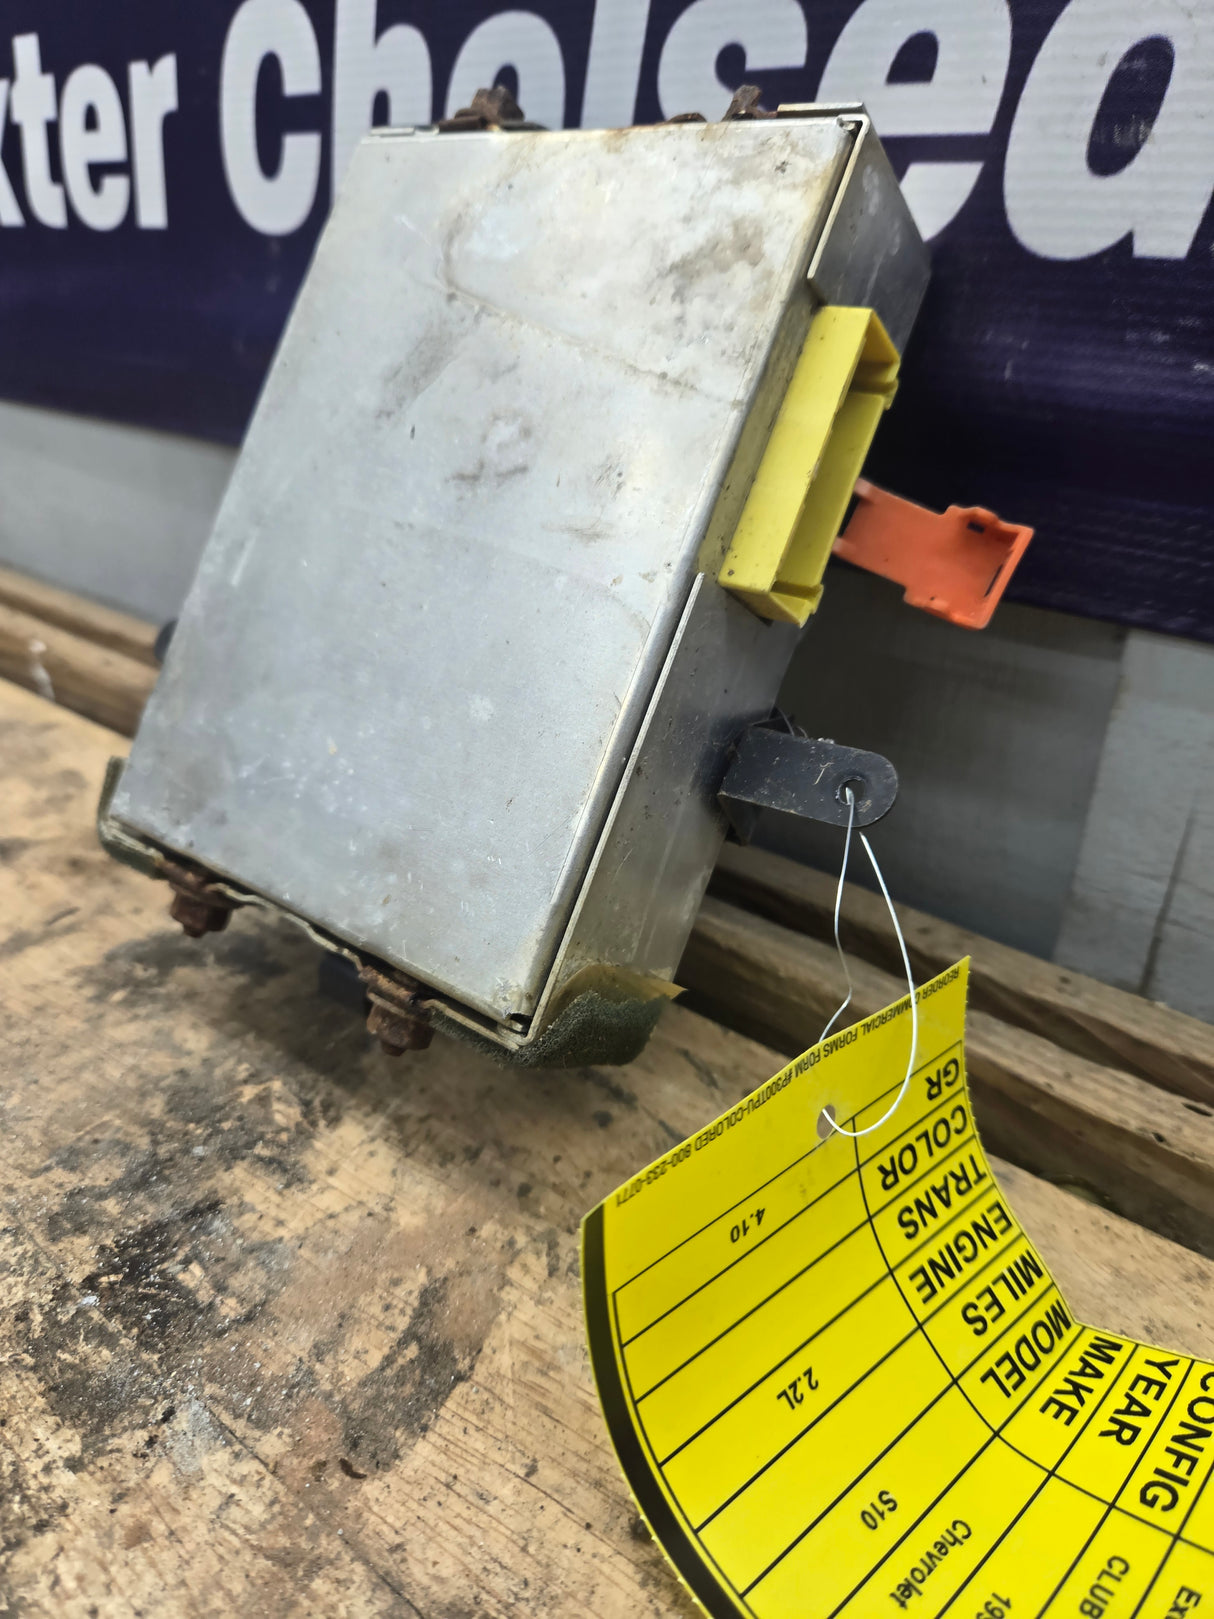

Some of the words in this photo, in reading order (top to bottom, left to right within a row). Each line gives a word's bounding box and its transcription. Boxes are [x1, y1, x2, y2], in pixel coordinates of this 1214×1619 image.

[861, 992, 922, 1032] COMMERCIAL
[922, 966, 960, 999] REORDER
[795, 1047, 821, 1078] FORM
[824, 1028, 858, 1054] FORMS
[925, 1057, 960, 1101] GR
[616, 1144, 692, 1208] 800-233-0771
[877, 1104, 968, 1191] COLOR
[730, 1208, 766, 1243] 4.10
[897, 1153, 987, 1240] TRANS
[908, 1200, 1014, 1304] ENGINE
[961, 1249, 1043, 1336] MILES
[979, 1298, 1072, 1399] MODEL
[1039, 1335, 1124, 1426] MAKE
[776, 1367, 819, 1410] 2.2L
[1098, 1358, 1181, 1446] YEAR
[860, 1490, 898, 1531] S10
[889, 1519, 972, 1610] Chevrolet
[1079, 1555, 1130, 1619] CLUB
[1164, 1585, 1203, 1619] Ex
